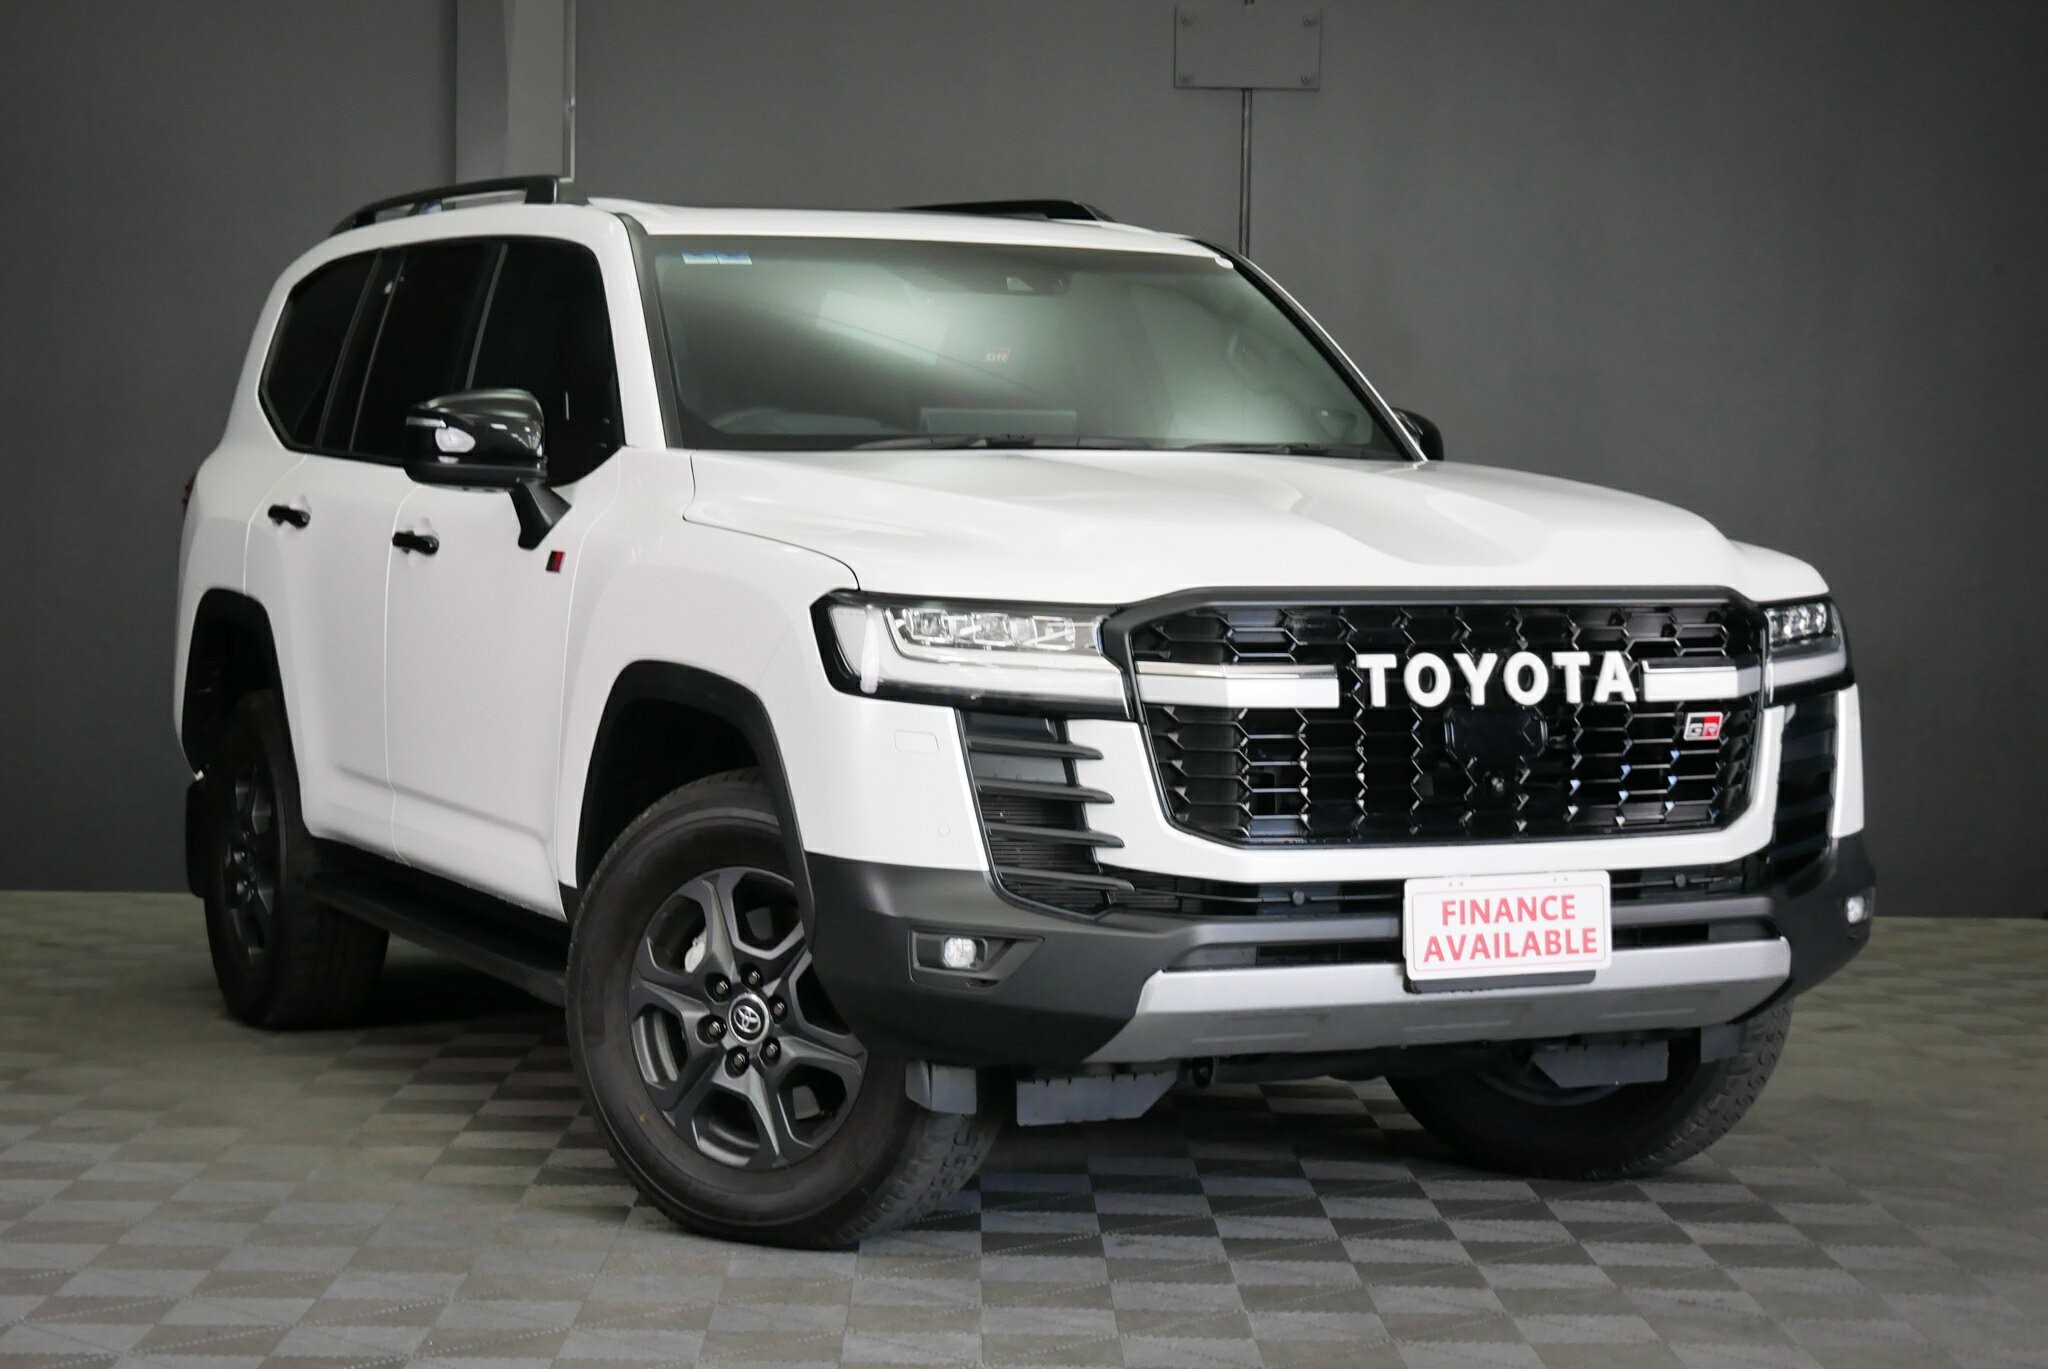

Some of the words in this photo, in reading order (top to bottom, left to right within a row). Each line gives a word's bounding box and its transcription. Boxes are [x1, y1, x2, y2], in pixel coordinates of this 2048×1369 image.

[1356, 651, 1637, 707] TOYOTA
[1441, 895, 1576, 926] FINANCE
[1423, 928, 1597, 963] AVAILABLE
